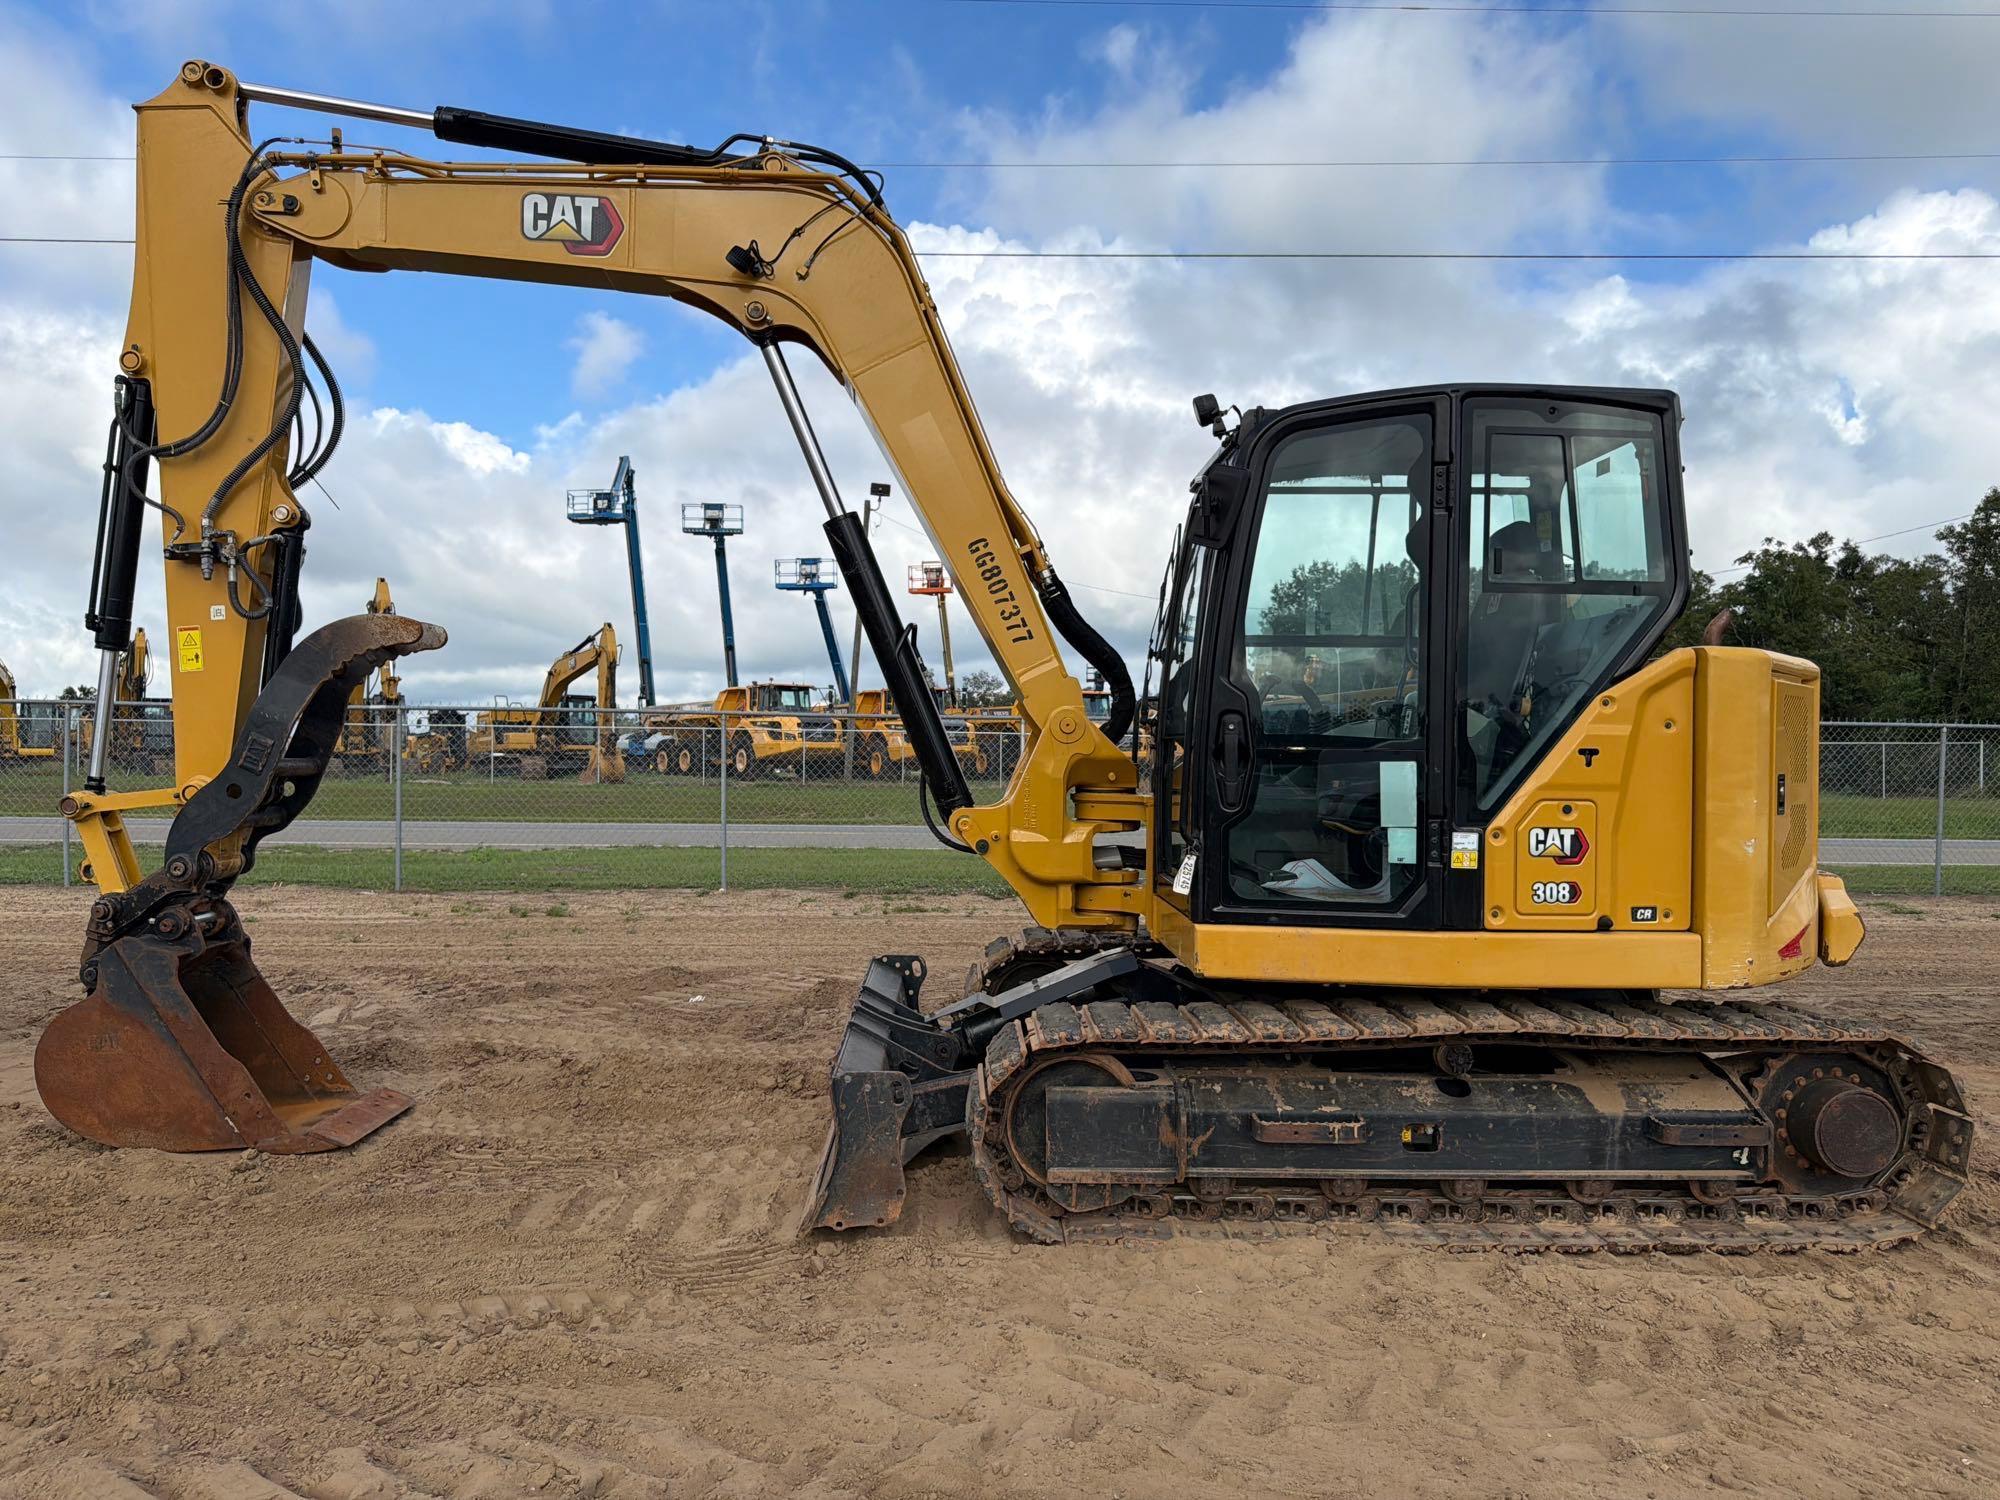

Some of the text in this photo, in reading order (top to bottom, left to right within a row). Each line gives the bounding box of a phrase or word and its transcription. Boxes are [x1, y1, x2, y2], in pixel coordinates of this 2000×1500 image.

[523, 193, 599, 242] CAT
[968, 537, 1034, 644] GG807377
[1529, 827, 1575, 857] CAT
[1180, 861, 1193, 890] 225745
[1532, 882, 1570, 903] 308
[1636, 908, 1652, 920] CR
